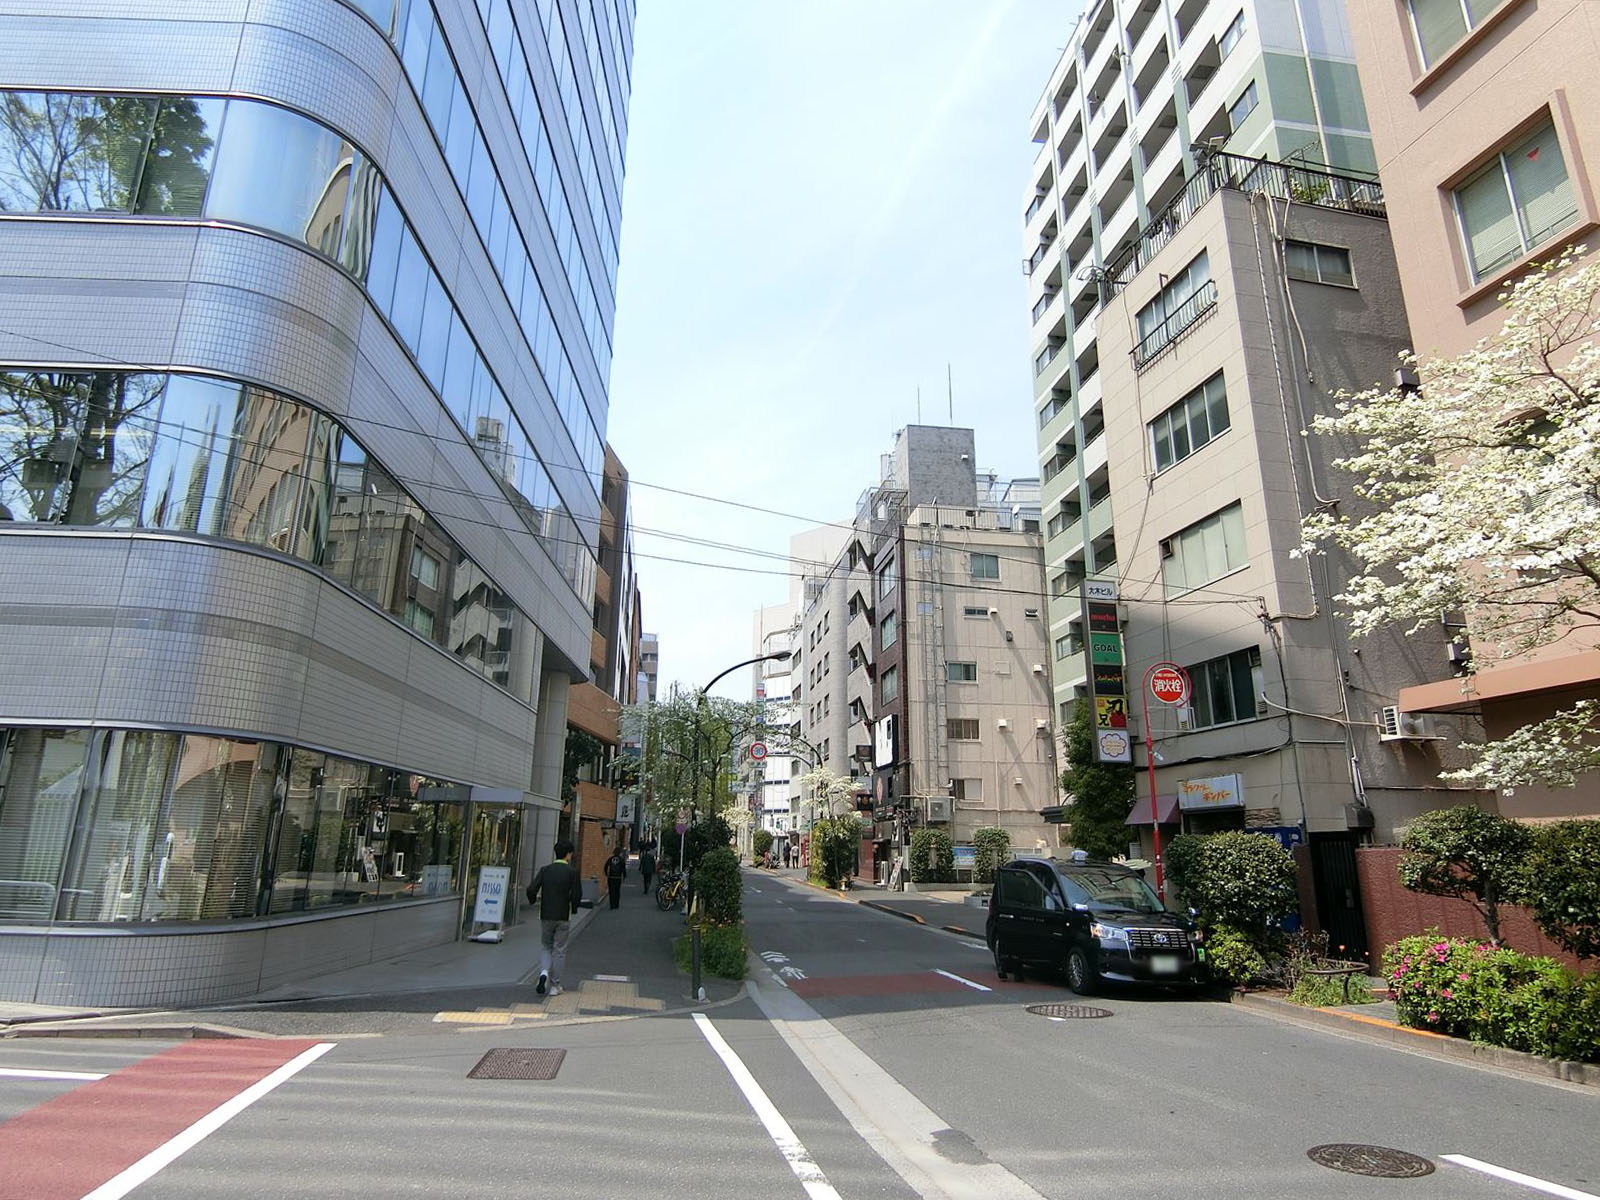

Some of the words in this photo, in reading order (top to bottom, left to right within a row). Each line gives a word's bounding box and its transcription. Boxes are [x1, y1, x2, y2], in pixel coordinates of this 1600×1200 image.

[1088, 586, 1113, 596] 大木ビル
[1093, 643, 1118, 653] GOAL
[1153, 678, 1182, 693] 消火栓
